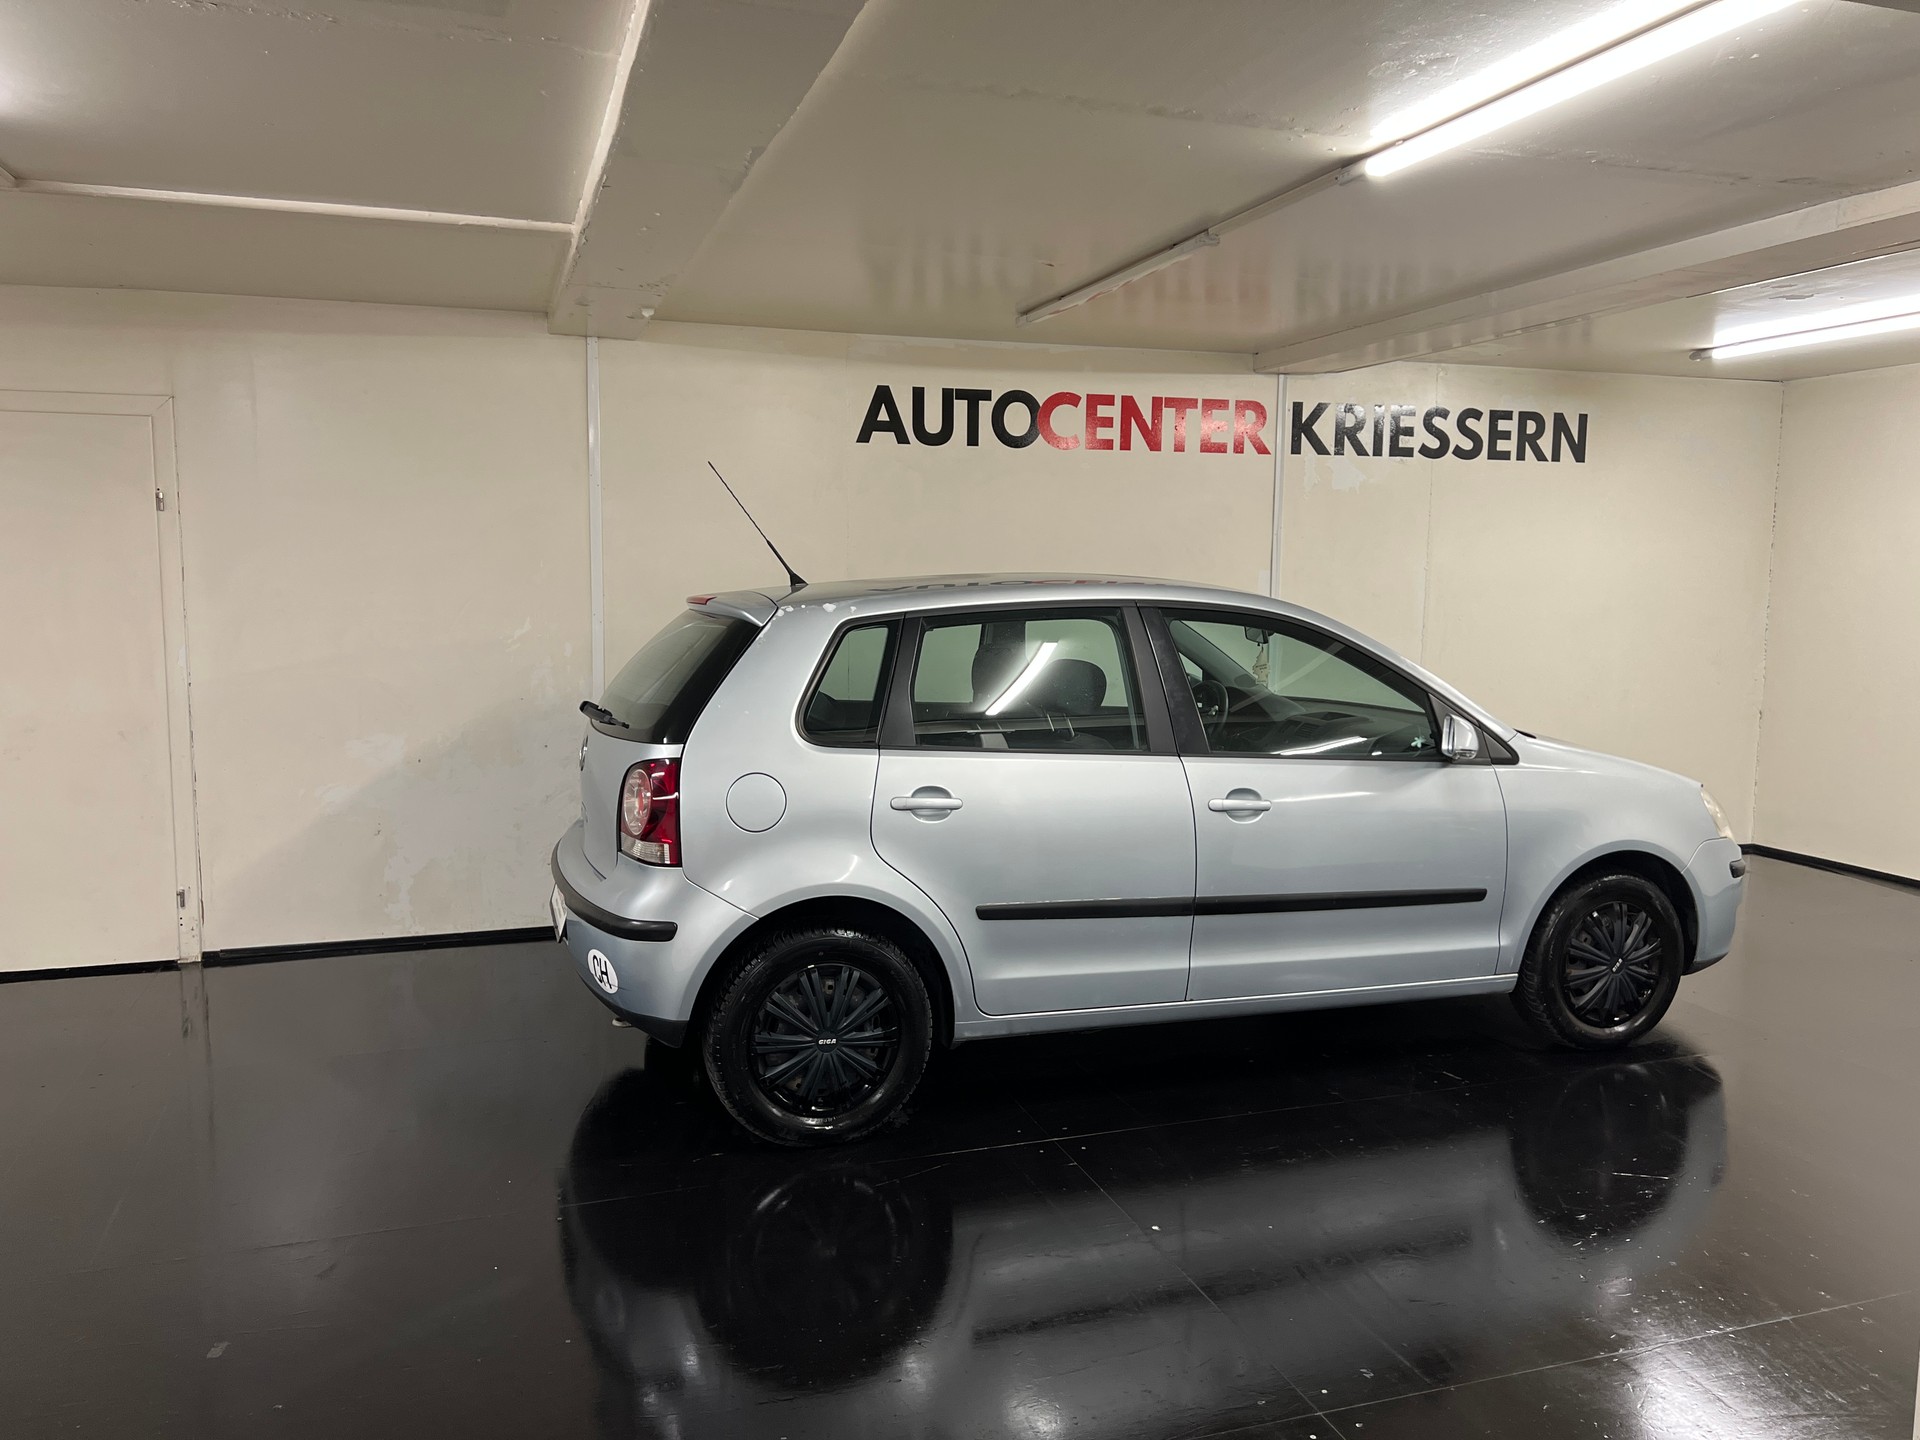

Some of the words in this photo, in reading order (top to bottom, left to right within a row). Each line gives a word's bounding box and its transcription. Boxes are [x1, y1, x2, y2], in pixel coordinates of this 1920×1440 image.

[856, 385, 1271, 455] AUTOCENTER
[1291, 401, 1588, 463] KRIESSERN
[593, 954, 613, 989] CH
